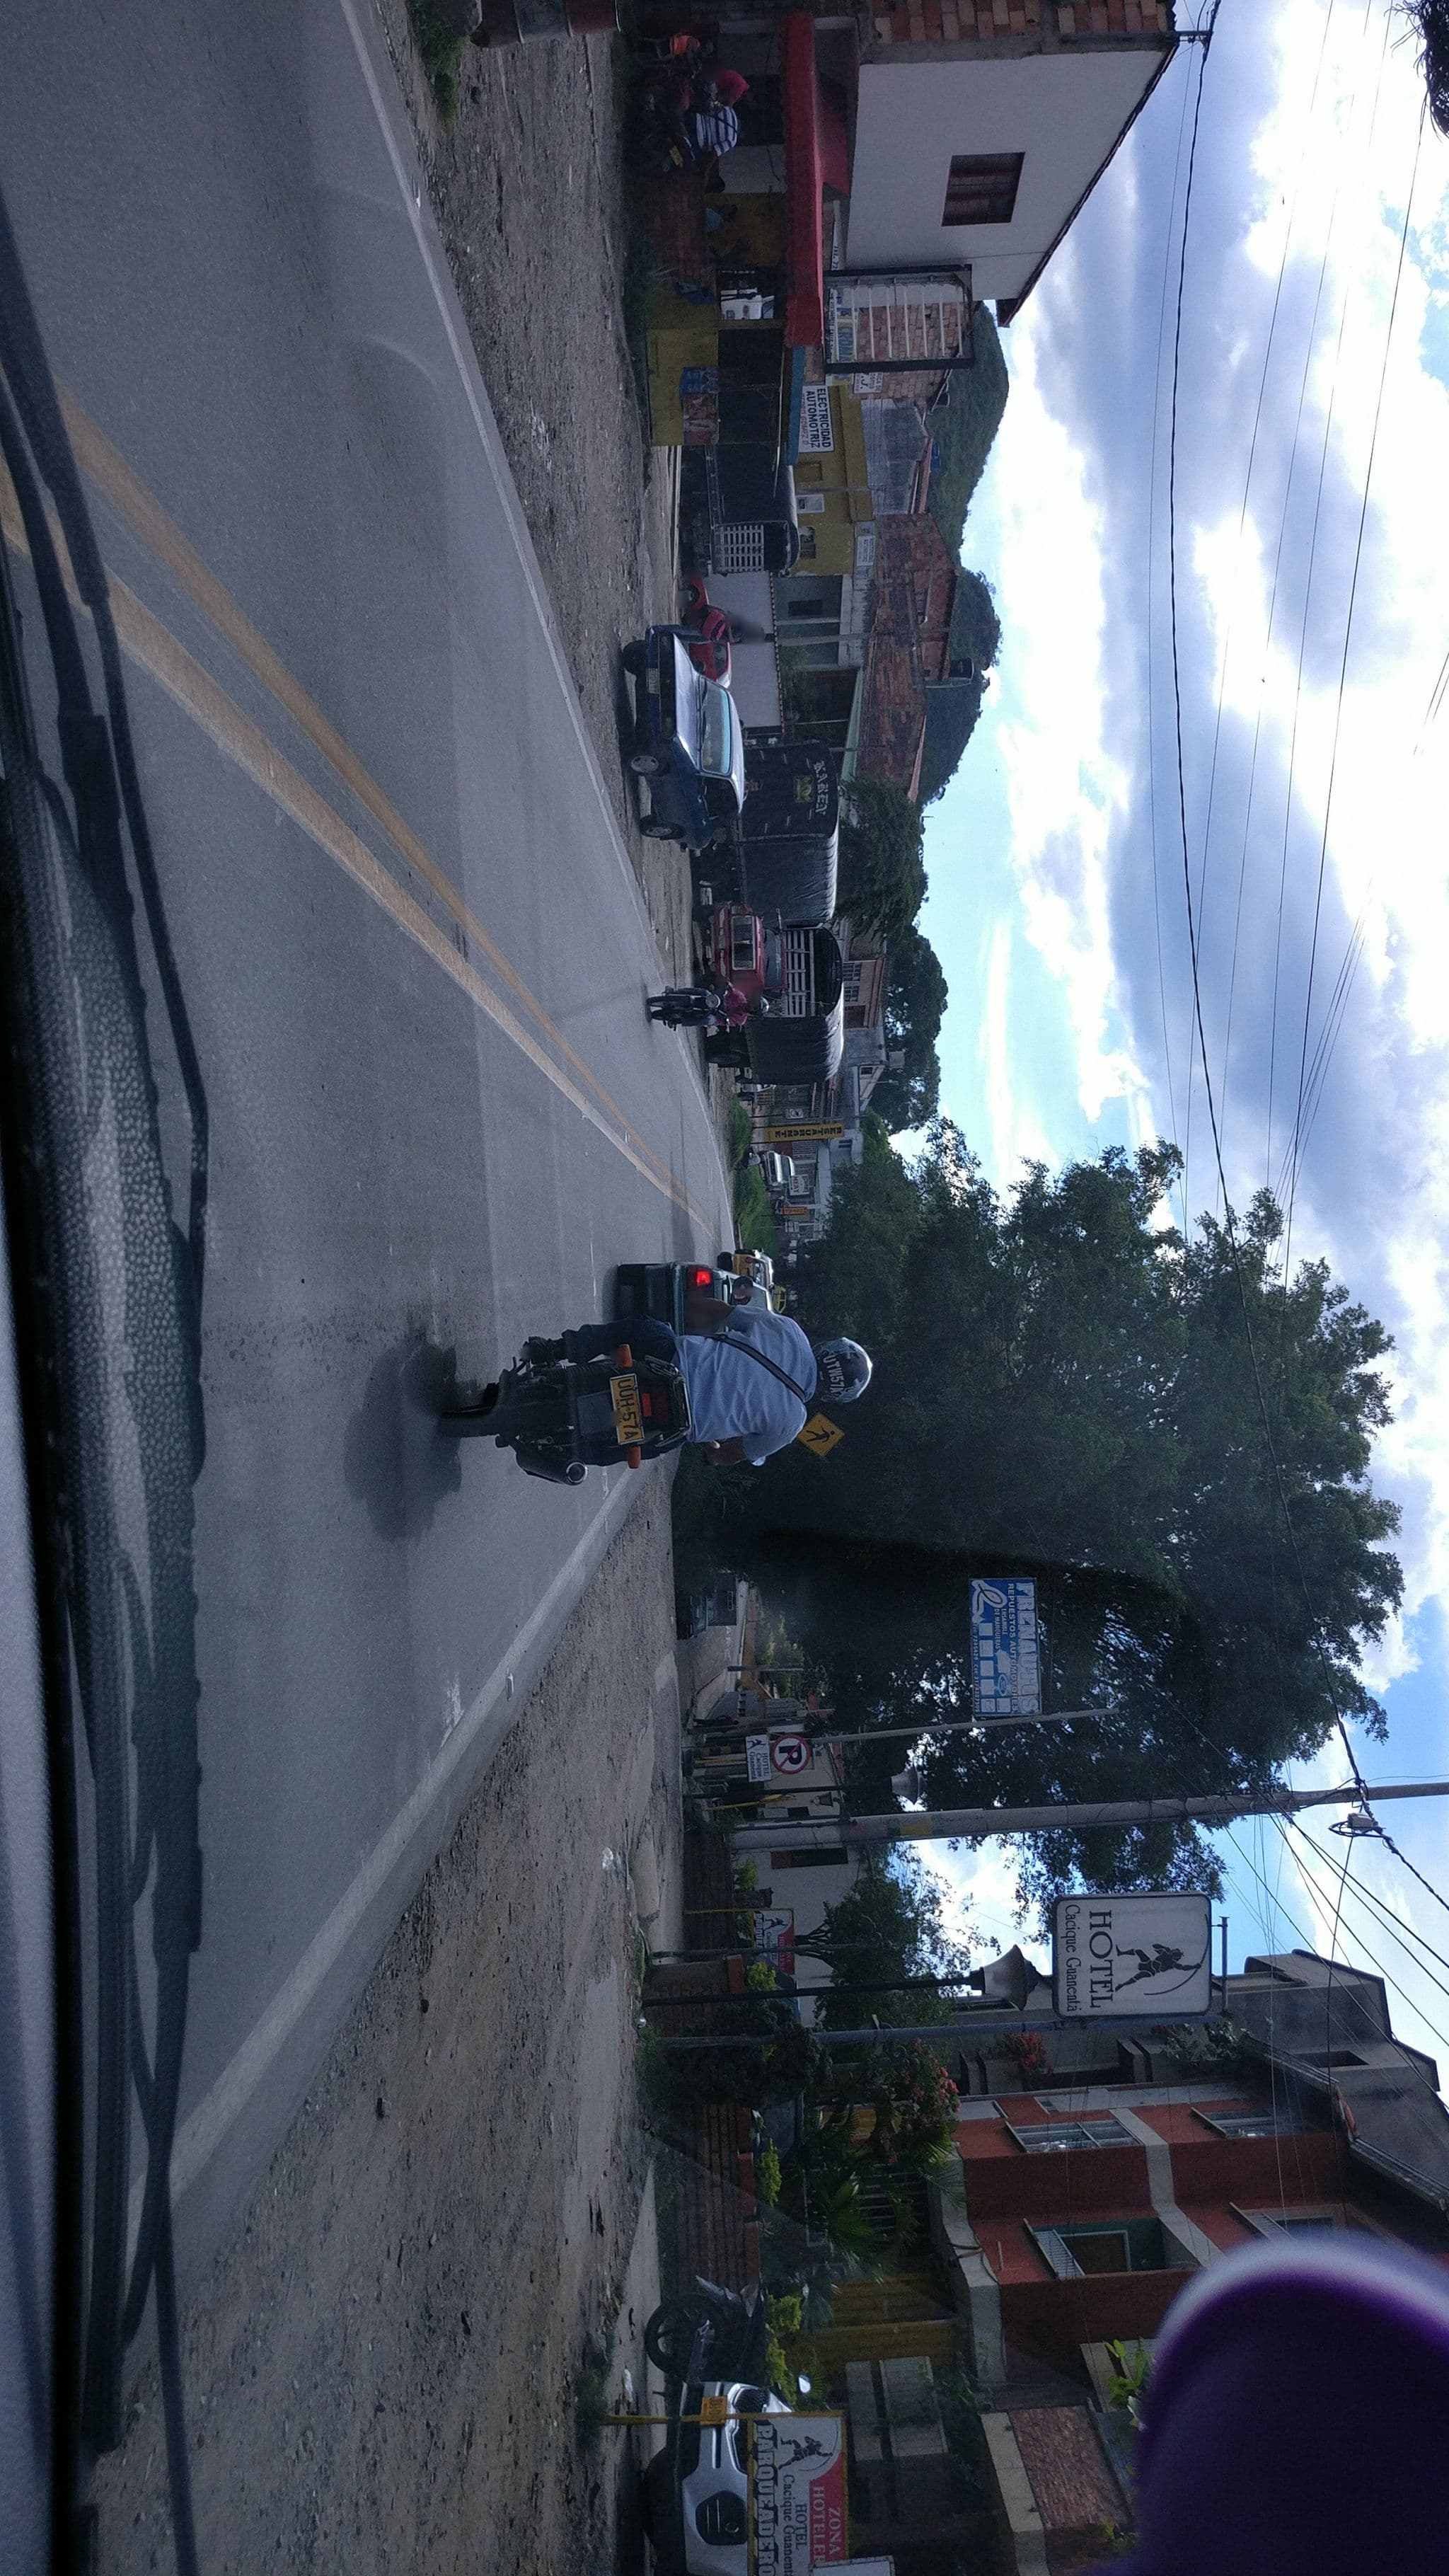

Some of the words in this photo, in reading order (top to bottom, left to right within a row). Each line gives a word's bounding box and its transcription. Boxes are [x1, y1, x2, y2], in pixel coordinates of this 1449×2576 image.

[807, 391, 820, 448] AUTOMOTRIZ
[817, 389, 831, 447] ELECTRICIDAD
[775, 1126, 842, 1138] RESTAURANTE
[823, 1355, 845, 1393] UTW57A
[1008, 1584, 1016, 1638] REPUESTOS
[1016, 1582, 1039, 1714] FRENAUTOS
[1009, 1640, 1017, 1711] AUTOMOTORES
[778, 1744, 802, 1765] P
[1061, 1904, 1080, 1953] Cacique
[1066, 1957, 1082, 2012] Guanentá
[1089, 1910, 1114, 2008] HOTEL
[780, 2474, 795, 2521] Cacique
[795, 2503, 807, 2551] HOTEL
[829, 2507, 841, 2554] ZONA
